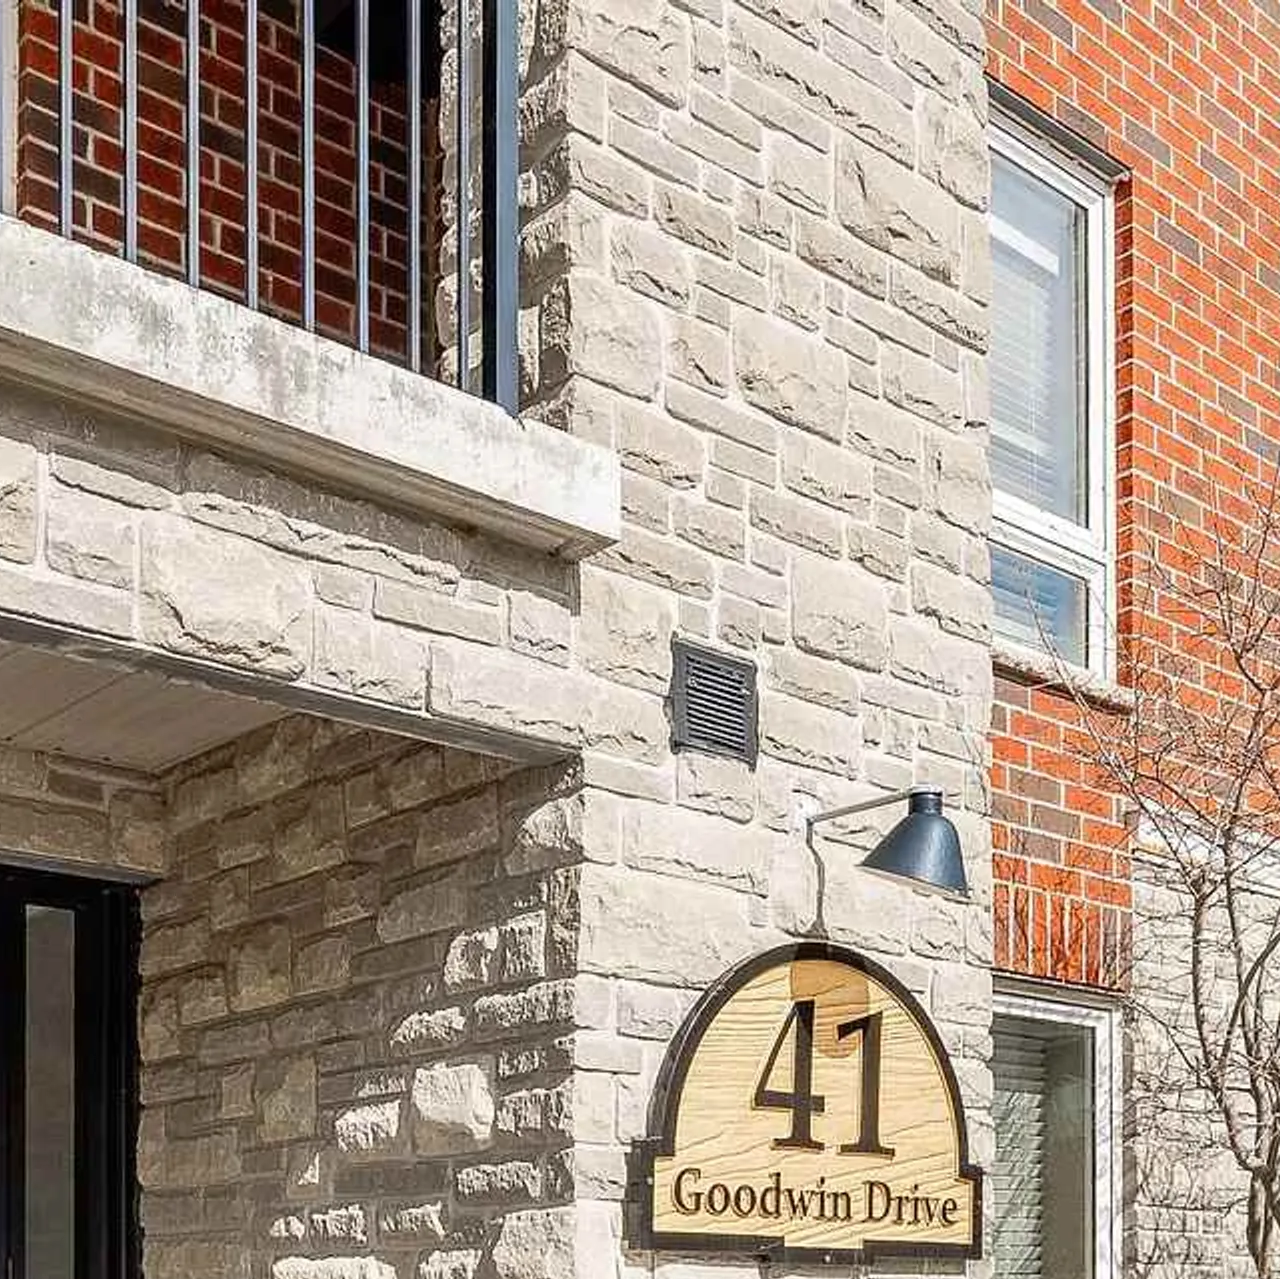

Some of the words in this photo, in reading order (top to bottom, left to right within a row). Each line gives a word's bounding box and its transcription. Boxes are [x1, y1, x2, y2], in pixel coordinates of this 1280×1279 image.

[753, 999, 895, 1157] 41
[673, 1167, 852, 1222] Goodwin
[864, 1180, 958, 1226] Drive
